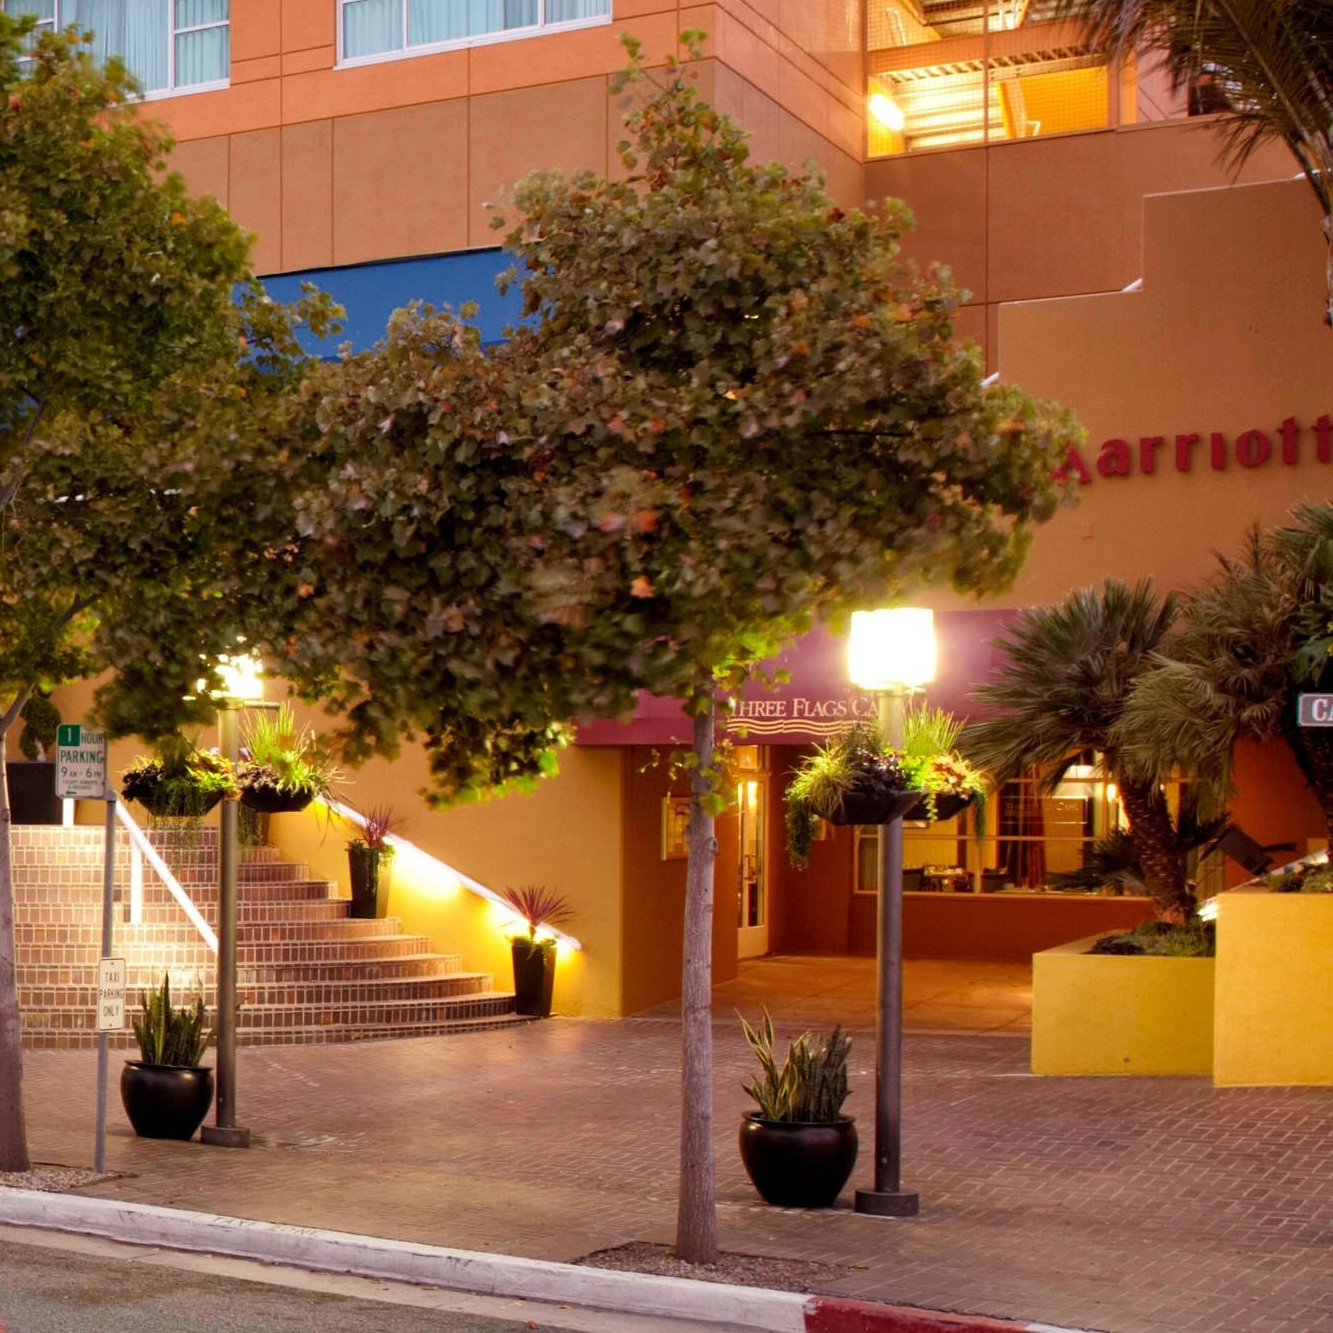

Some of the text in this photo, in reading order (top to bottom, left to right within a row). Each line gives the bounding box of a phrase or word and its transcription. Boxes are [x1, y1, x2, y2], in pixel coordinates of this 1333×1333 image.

[792, 697, 846, 716] FLAGS
[67, 728, 103, 744] 1 HOUR
[60, 750, 105, 764] PARKING
[61, 767, 68, 777] 9
[85, 767, 93, 778] 6
[105, 972, 119, 982] TAXI
[99, 988, 123, 999] PARKING
[103, 1006, 119, 1017] ONLY
